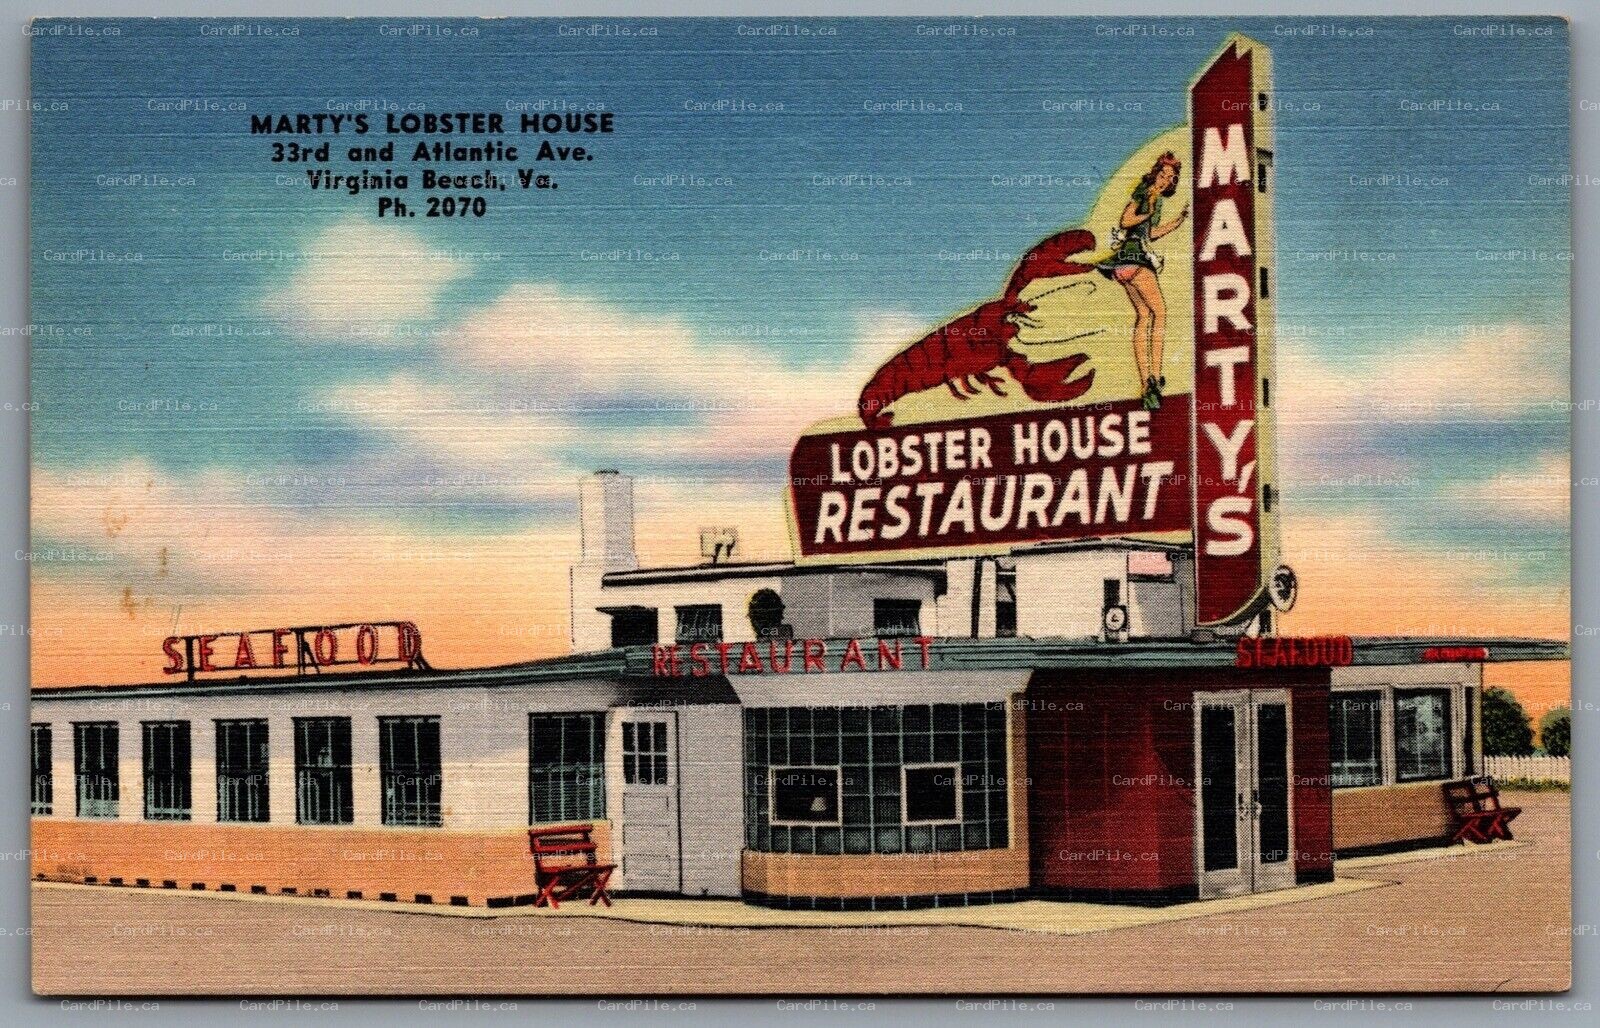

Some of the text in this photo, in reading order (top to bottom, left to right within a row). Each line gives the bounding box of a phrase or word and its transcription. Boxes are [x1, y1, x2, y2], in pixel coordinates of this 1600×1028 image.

[1197, 123, 1256, 557] MARTY'S
[831, 410, 1153, 484] LOBSTER HOUSE
[814, 461, 1175, 544] RESTAURANT
[162, 620, 422, 675] SEAFOOD
[652, 635, 935, 678] RESTAURANT
